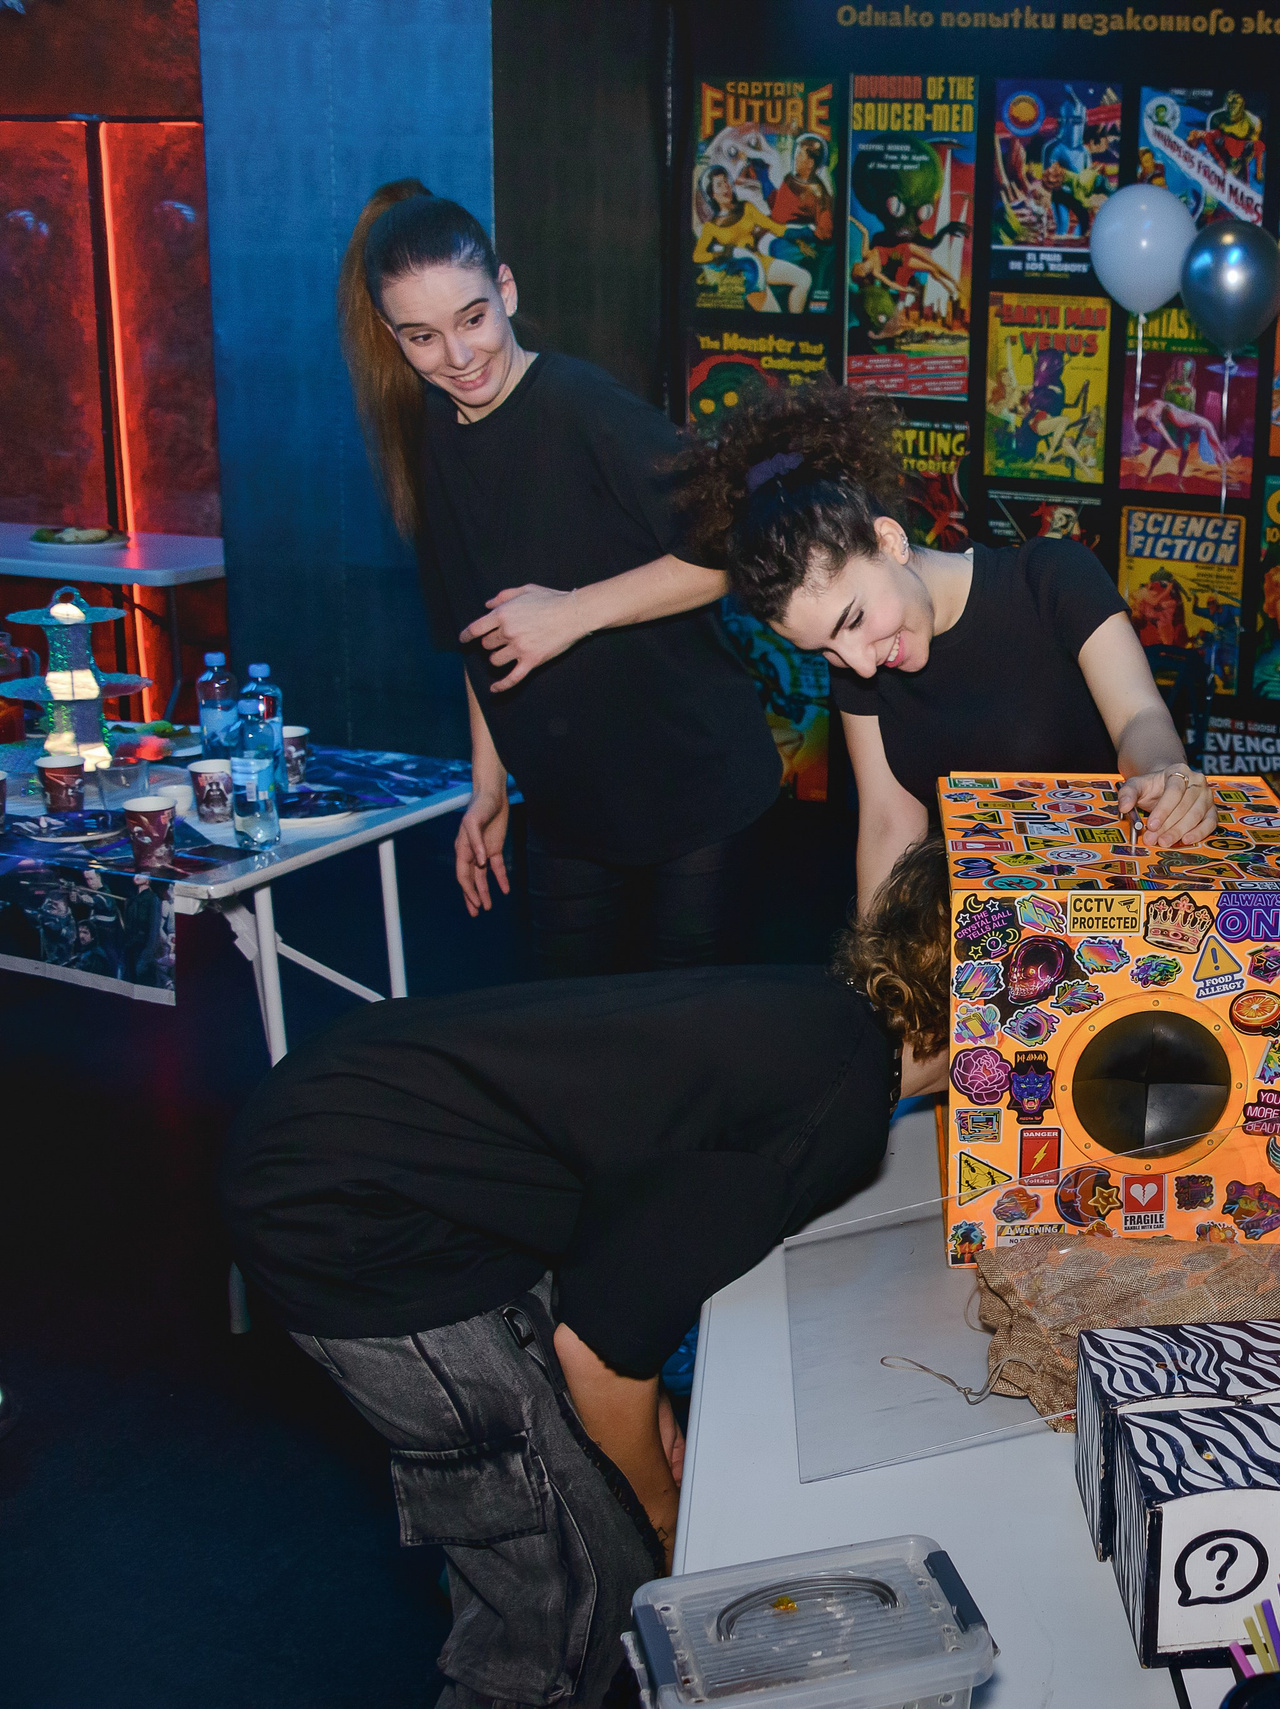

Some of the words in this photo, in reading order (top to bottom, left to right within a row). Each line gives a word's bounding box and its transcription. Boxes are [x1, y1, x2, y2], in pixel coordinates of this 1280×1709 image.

[837, 5, 934, 28] Однако
[941, 9, 1057, 31] попытки
[1062, 7, 1236, 36] незаконного
[725, 81, 805, 95] CAPTAIN
[926, 76, 945, 100] OF
[947, 76, 975, 101] THE
[701, 82, 834, 142] FUTURE
[852, 102, 975, 132] SAUCER-MEN
[1001, 304, 1060, 329] EARTH
[722, 332, 796, 354] Monster
[1020, 332, 1098, 357] VENUS
[1131, 511, 1240, 542] SCIENCE
[1129, 535, 1237, 565] FICTION
[1073, 898, 1114, 913] CCTV
[956, 918, 991, 940] CRYSTAL
[991, 909, 1013, 923] BALL
[972, 910, 990, 923] THE
[1072, 916, 1138, 930] PROTECTED
[966, 926, 992, 941] TELLS
[991, 920, 1008, 930] ALL
[1198, 980, 1244, 998] ALLERGY
[1205, 975, 1234, 987] FOOD
[1246, 1105, 1280, 1119] MORE
[1015, 1226, 1059, 1235] WARNING
[1124, 1214, 1165, 1226] FRAGILE
